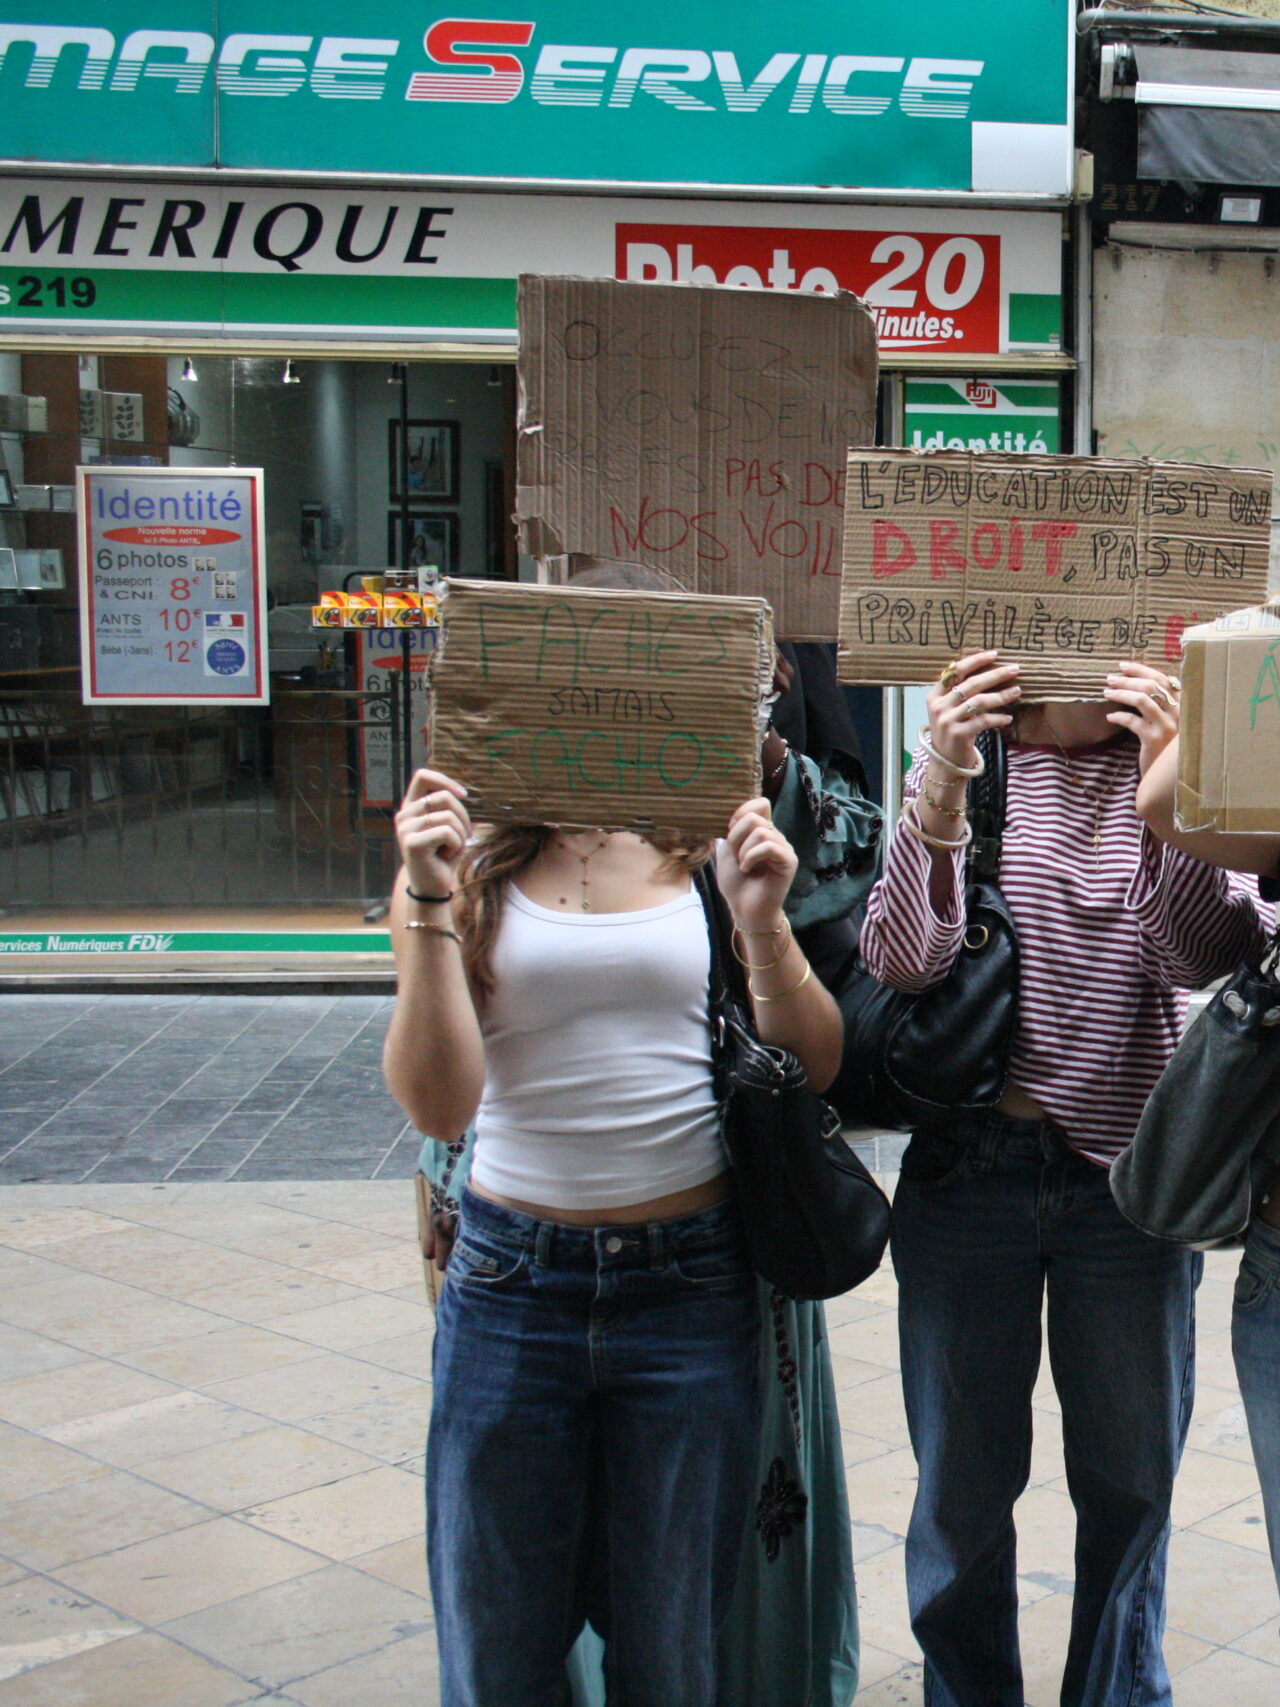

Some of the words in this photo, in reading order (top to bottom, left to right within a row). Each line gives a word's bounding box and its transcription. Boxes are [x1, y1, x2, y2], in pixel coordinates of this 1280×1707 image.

[405, 18, 985, 119] SERVICE
[1100, 183, 1161, 212] 217
[0, 195, 455, 272] MERIQUE
[863, 236, 985, 311] 20
[17, 276, 96, 308] 219
[596, 386, 731, 432] VOUS
[736, 395, 811, 442] DE
[821, 403, 873, 446] NOS
[913, 430, 1048, 453] Identité
[726, 458, 785, 497] PAS
[799, 463, 846, 508] DE
[98, 488, 241, 520] Identité
[1143, 476, 1217, 518] EST
[1229, 489, 1269, 525] UN
[138, 527, 176, 536] Nouvelle
[179, 528, 207, 536] norme
[611, 497, 729, 561] NOS
[97, 549, 113, 570] 6
[118, 551, 188, 571] photos
[1092, 531, 1170, 580] PAS
[1185, 539, 1244, 579] UN
[95, 575, 152, 588] Passeport
[115, 590, 153, 600] CNI
[101, 614, 141, 625] ANTS
[1111, 614, 1157, 648] DE
[101, 645, 122, 655] Bébé
[550, 687, 676, 721] JAMAIS
[484, 729, 742, 791] FACHOS
[47, 935, 124, 952] Numériques
